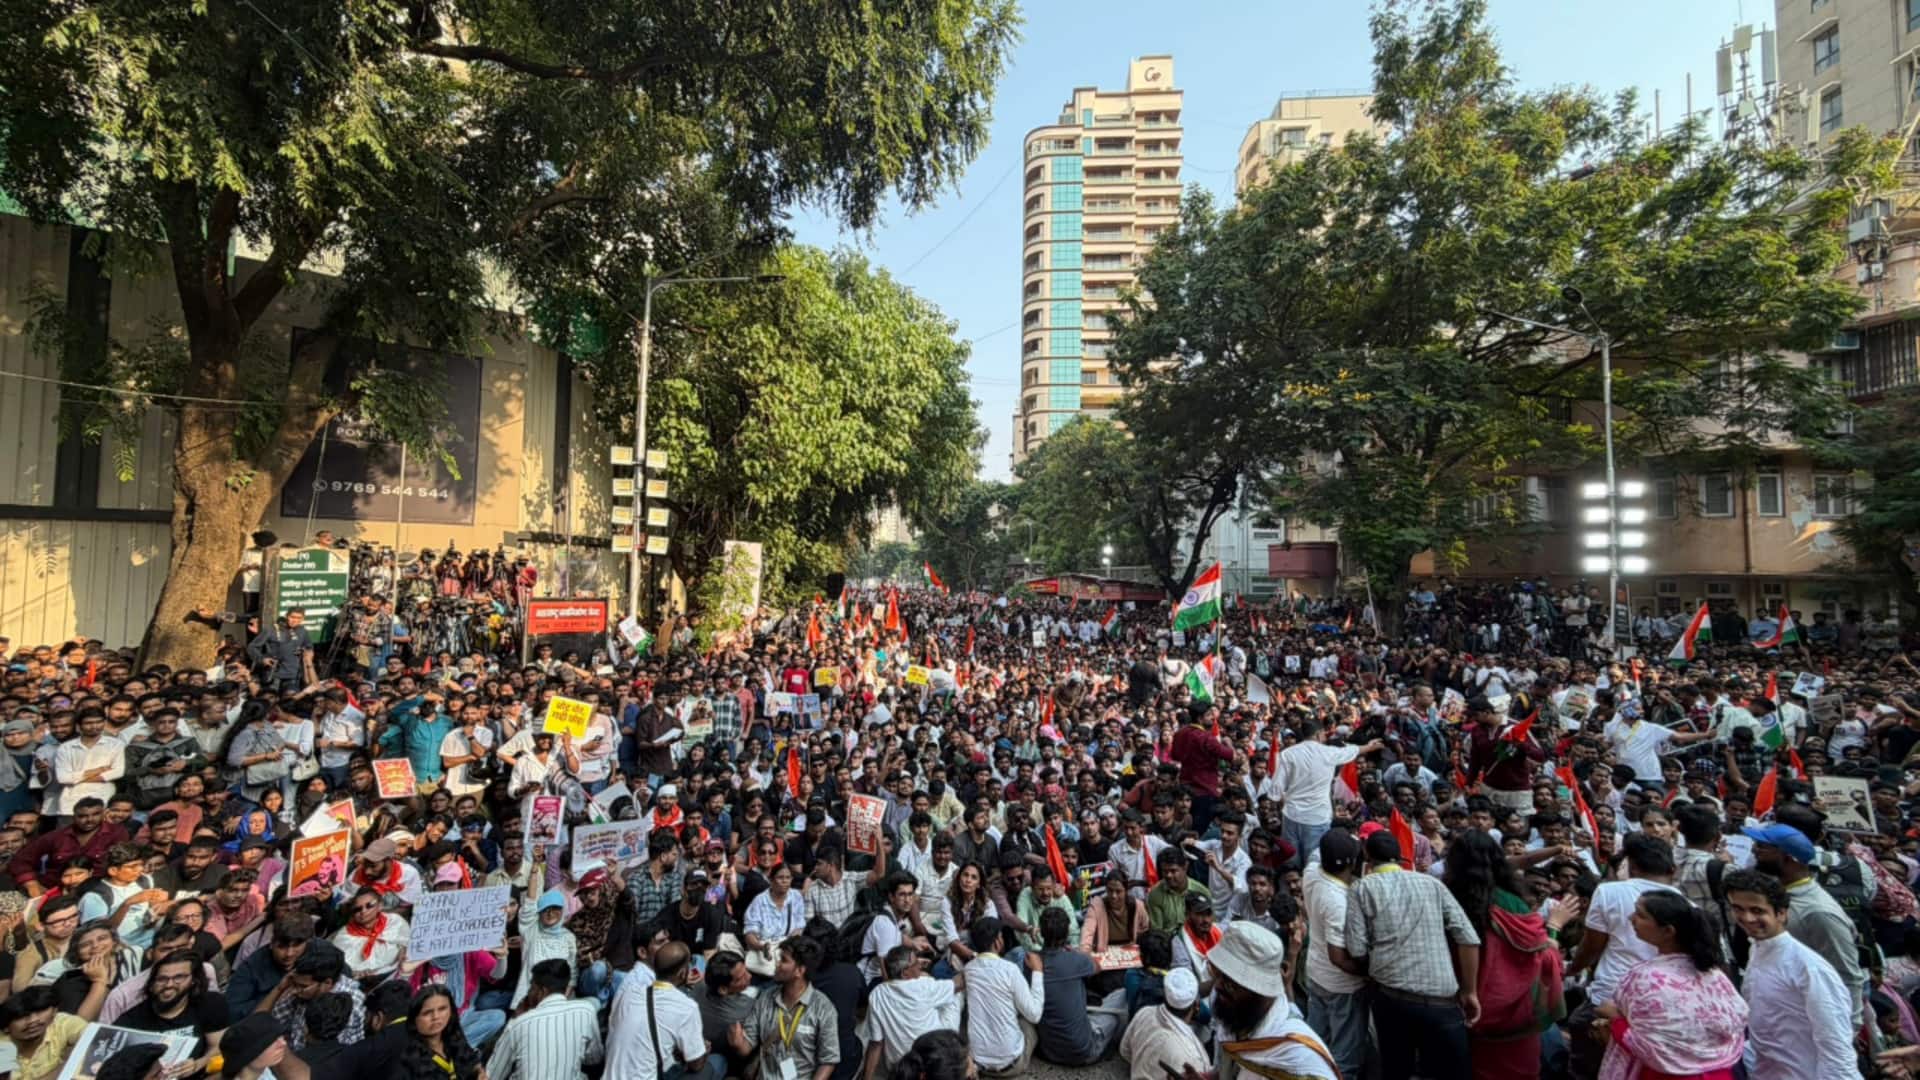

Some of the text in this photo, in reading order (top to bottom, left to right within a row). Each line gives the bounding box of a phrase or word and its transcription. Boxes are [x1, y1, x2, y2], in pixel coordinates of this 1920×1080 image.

[331, 481, 449, 499] 9769 544 544
